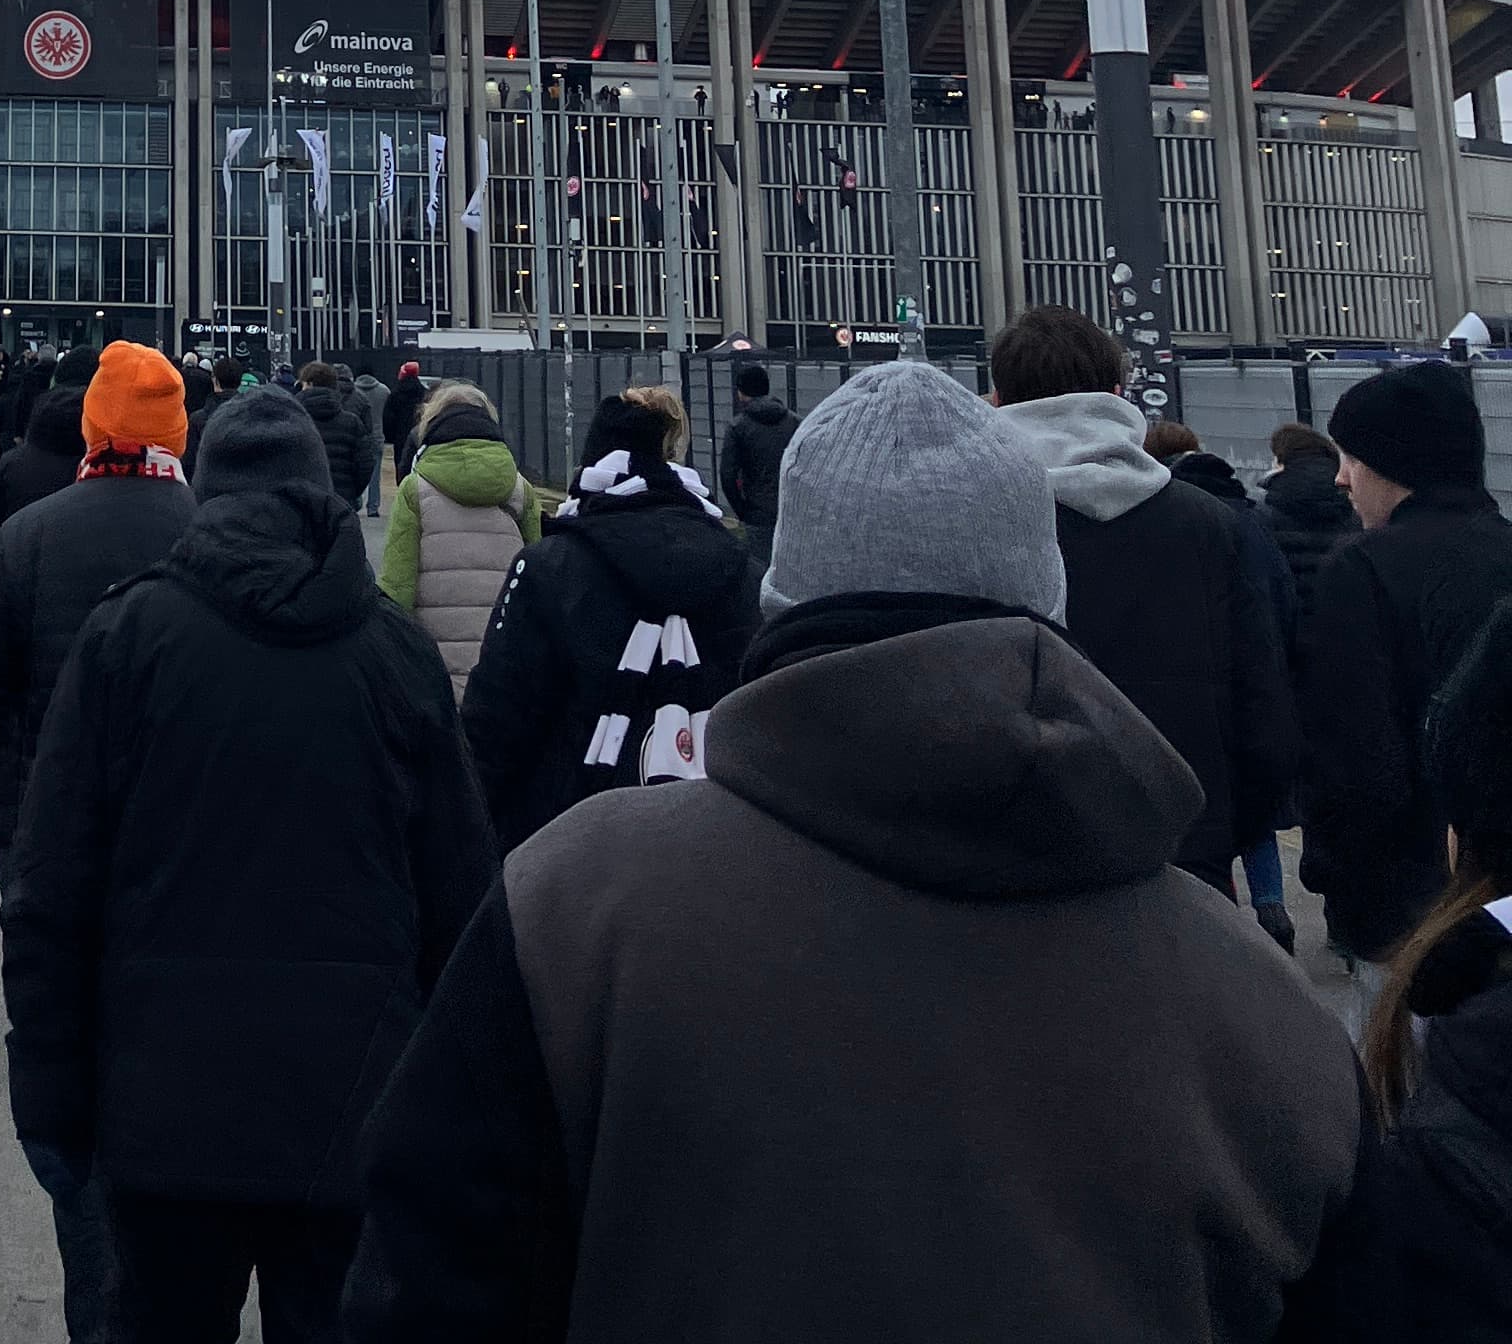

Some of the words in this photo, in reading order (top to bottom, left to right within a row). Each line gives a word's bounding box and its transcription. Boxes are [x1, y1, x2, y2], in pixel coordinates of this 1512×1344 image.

[330, 32, 414, 51] mainova
[314, 60, 361, 74] Unsere
[364, 62, 414, 78] Energie
[310, 75, 329, 88] fü
[331, 75, 352, 88] die
[355, 76, 416, 90] Eintracht
[855, 331, 900, 343] FANSHO
